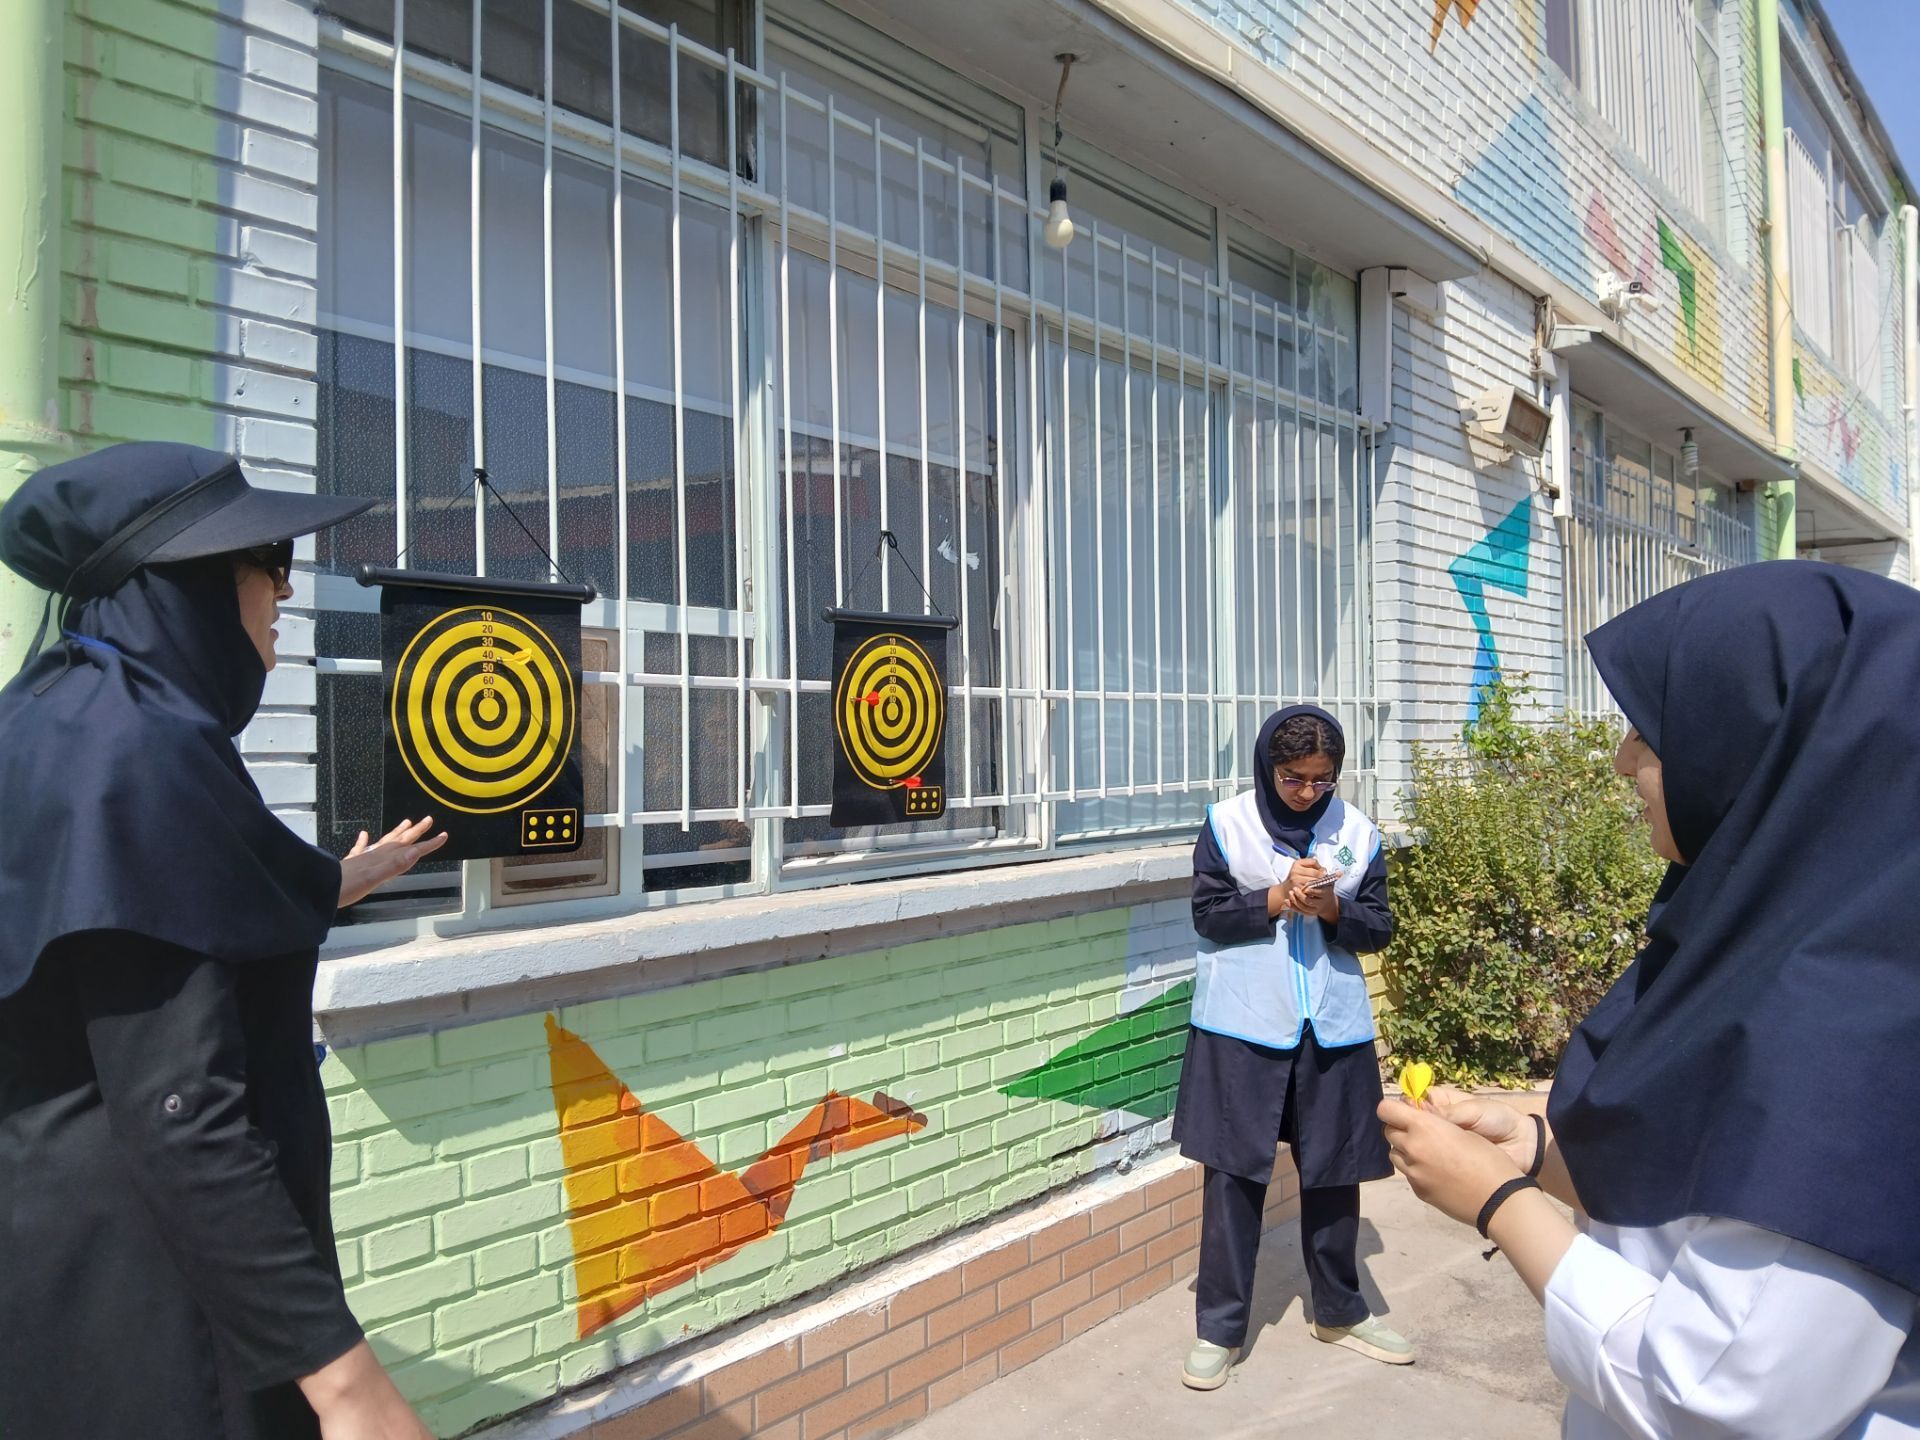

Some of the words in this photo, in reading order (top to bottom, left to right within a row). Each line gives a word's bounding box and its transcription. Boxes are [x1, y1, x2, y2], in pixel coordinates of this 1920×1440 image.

[481, 612, 492, 620] 10
[482, 624, 493, 634] 20
[482, 637, 494, 646] 30
[482, 650, 494, 659] 40
[482, 663, 494, 672] 50
[483, 676, 494, 685] 60
[483, 689, 494, 698] 80
